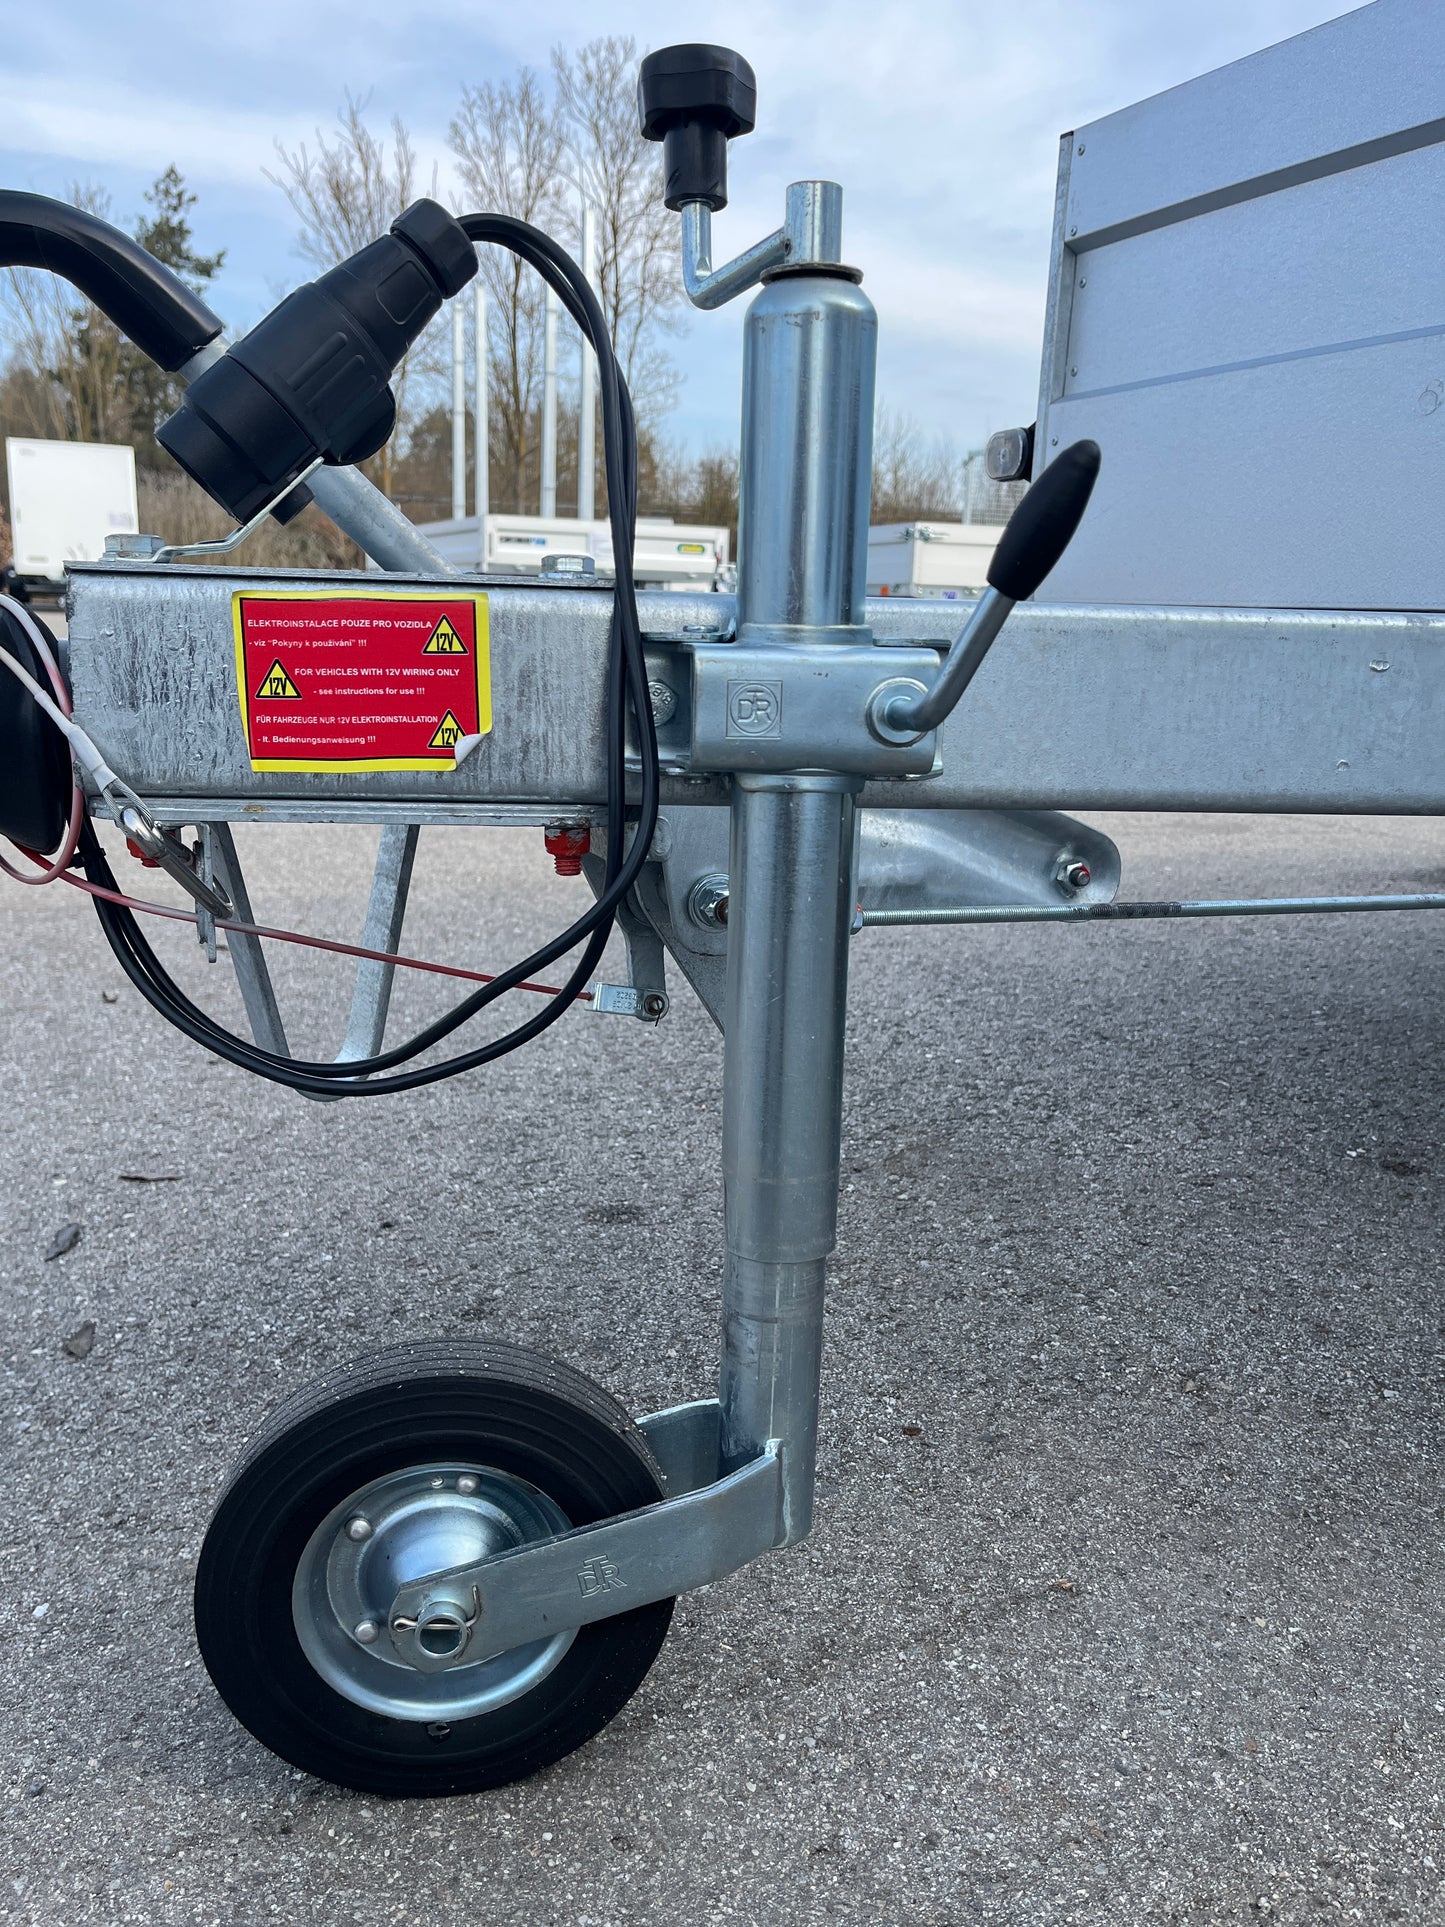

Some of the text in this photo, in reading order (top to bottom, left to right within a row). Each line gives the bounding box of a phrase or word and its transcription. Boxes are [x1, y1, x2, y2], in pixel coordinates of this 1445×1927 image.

[247, 619, 433, 629] ELEKTROINSTALACE POUZE PRO VOZIDLA
[253, 639, 266, 647] viz
[305, 639, 311, 647] k
[358, 639, 367, 647] !!!
[436, 633, 455, 652] 12V
[294, 667, 460, 677] FOR VEHICLES WITH 12V WIRING ONLY
[268, 678, 287, 696] 12V
[334, 687, 384, 695] instructions
[385, 687, 398, 695] for
[416, 687, 426, 695] !!!
[255, 714, 438, 724] FÜR FAHRZEUGE NUR 12V ELEKTROINSTALLATION
[272, 735, 366, 745] Bedienungsanweisung
[367, 735, 376, 743] !!!
[440, 727, 459, 746] 12V
